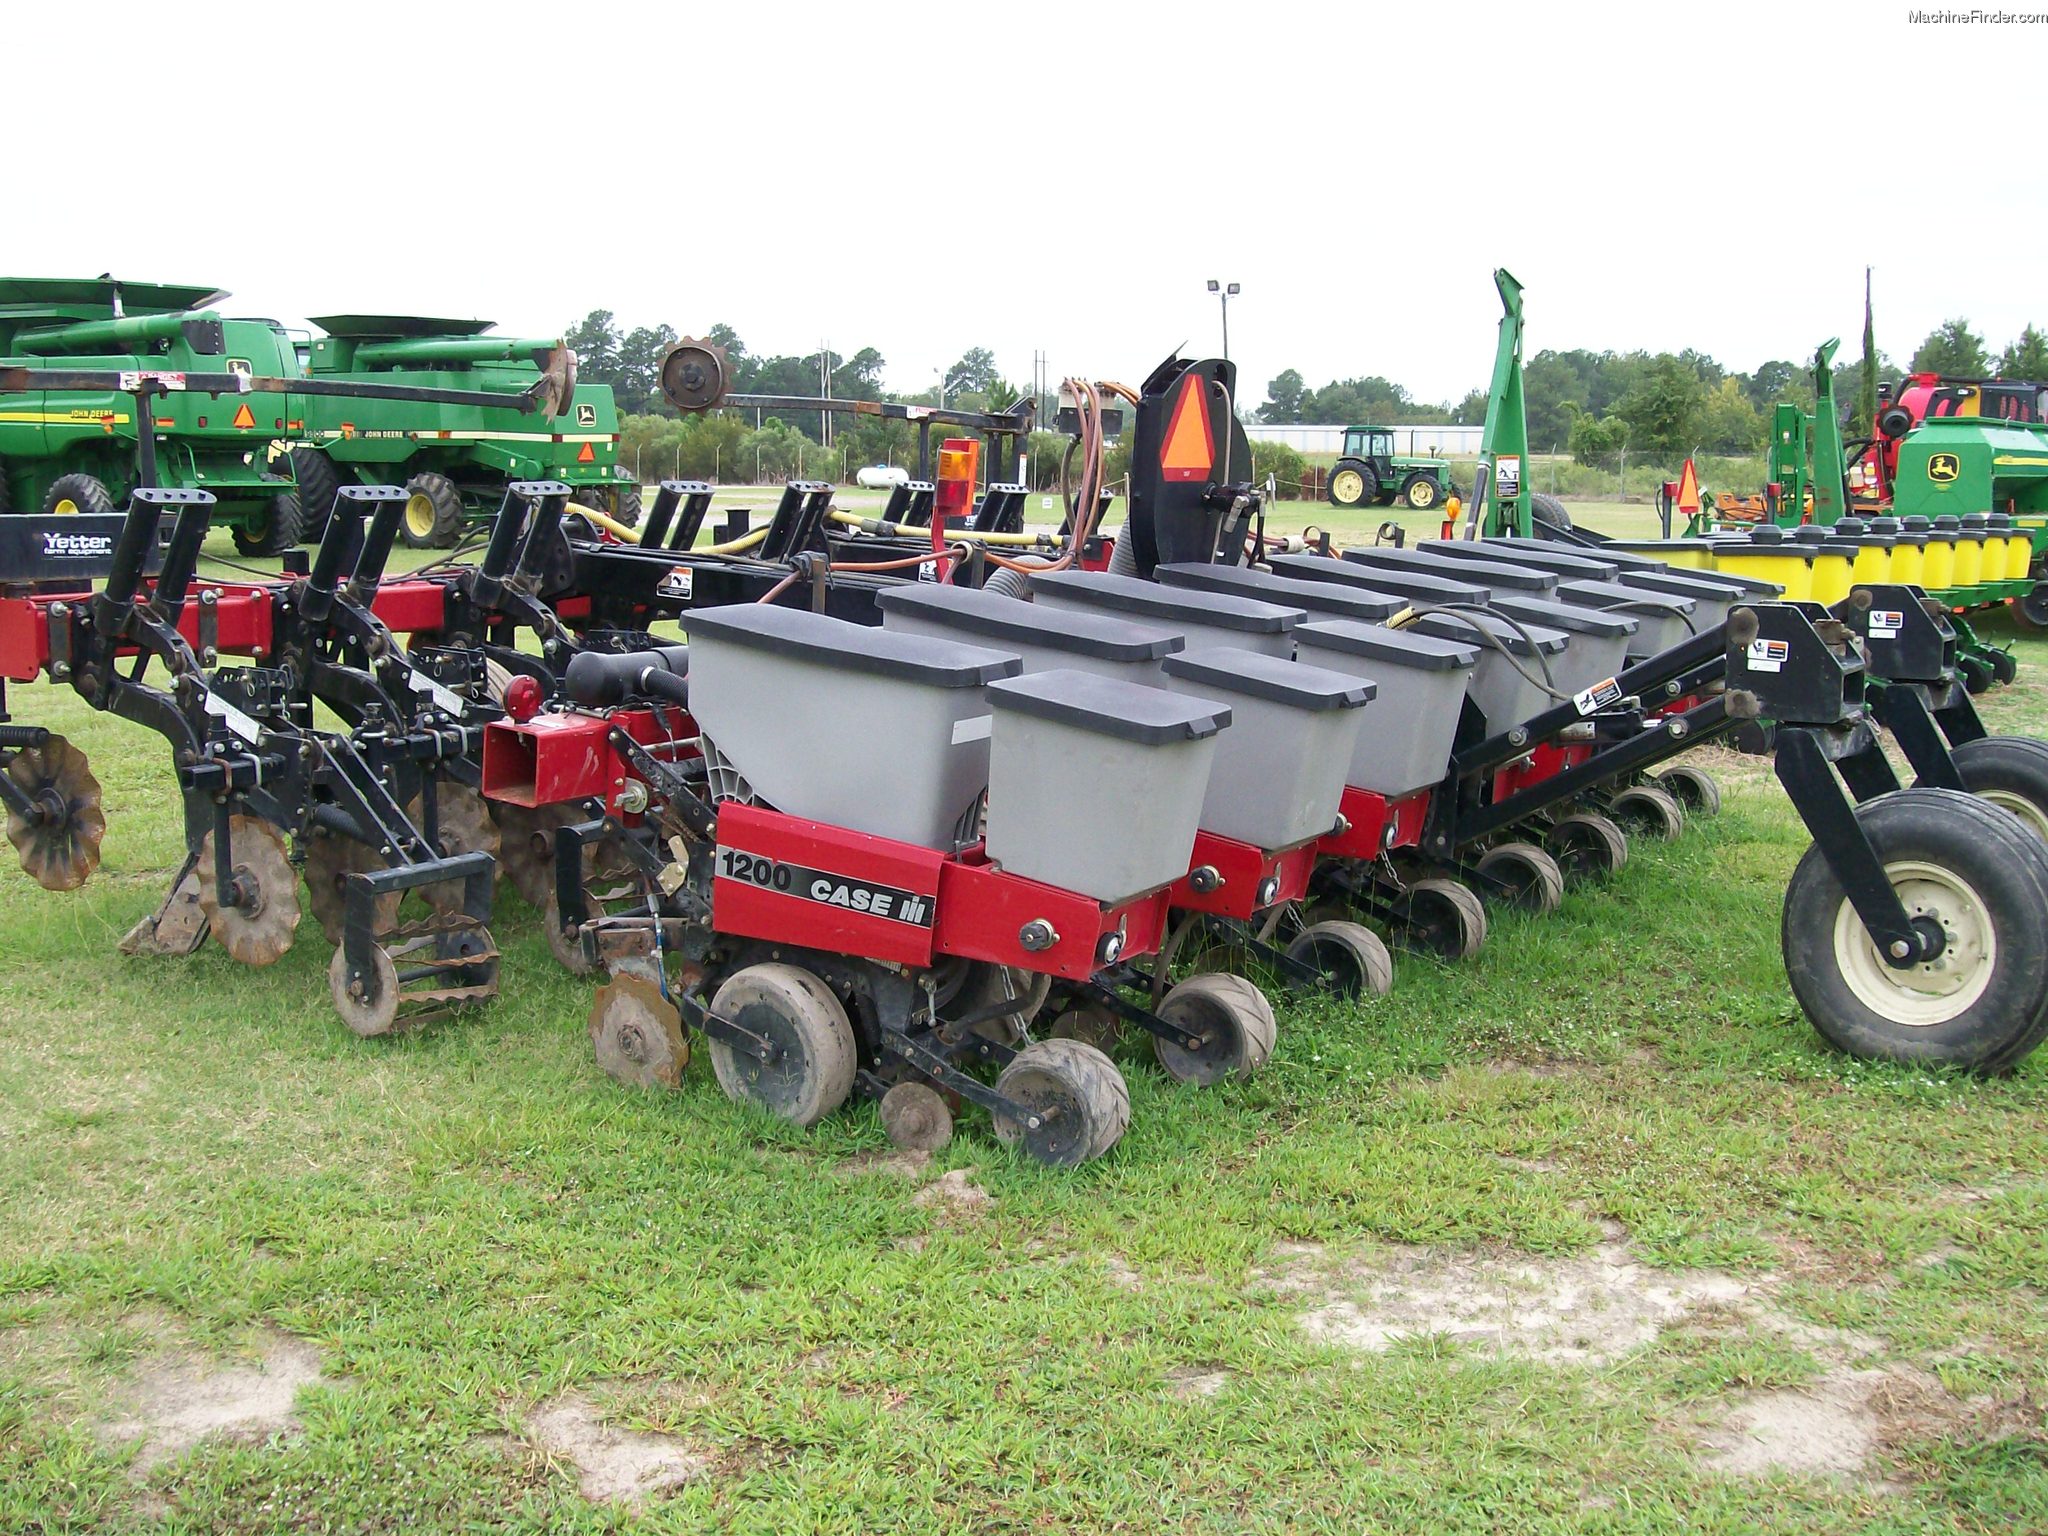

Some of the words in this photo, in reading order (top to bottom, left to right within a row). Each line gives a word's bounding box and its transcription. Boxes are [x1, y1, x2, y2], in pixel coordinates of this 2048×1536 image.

[71, 409, 89, 418] JOHN
[364, 430, 381, 438] JOHN
[382, 430, 403, 438] DEERE
[43, 532, 112, 548] Yetter
[722, 851, 792, 890] 1200
[810, 879, 893, 915] CASE
